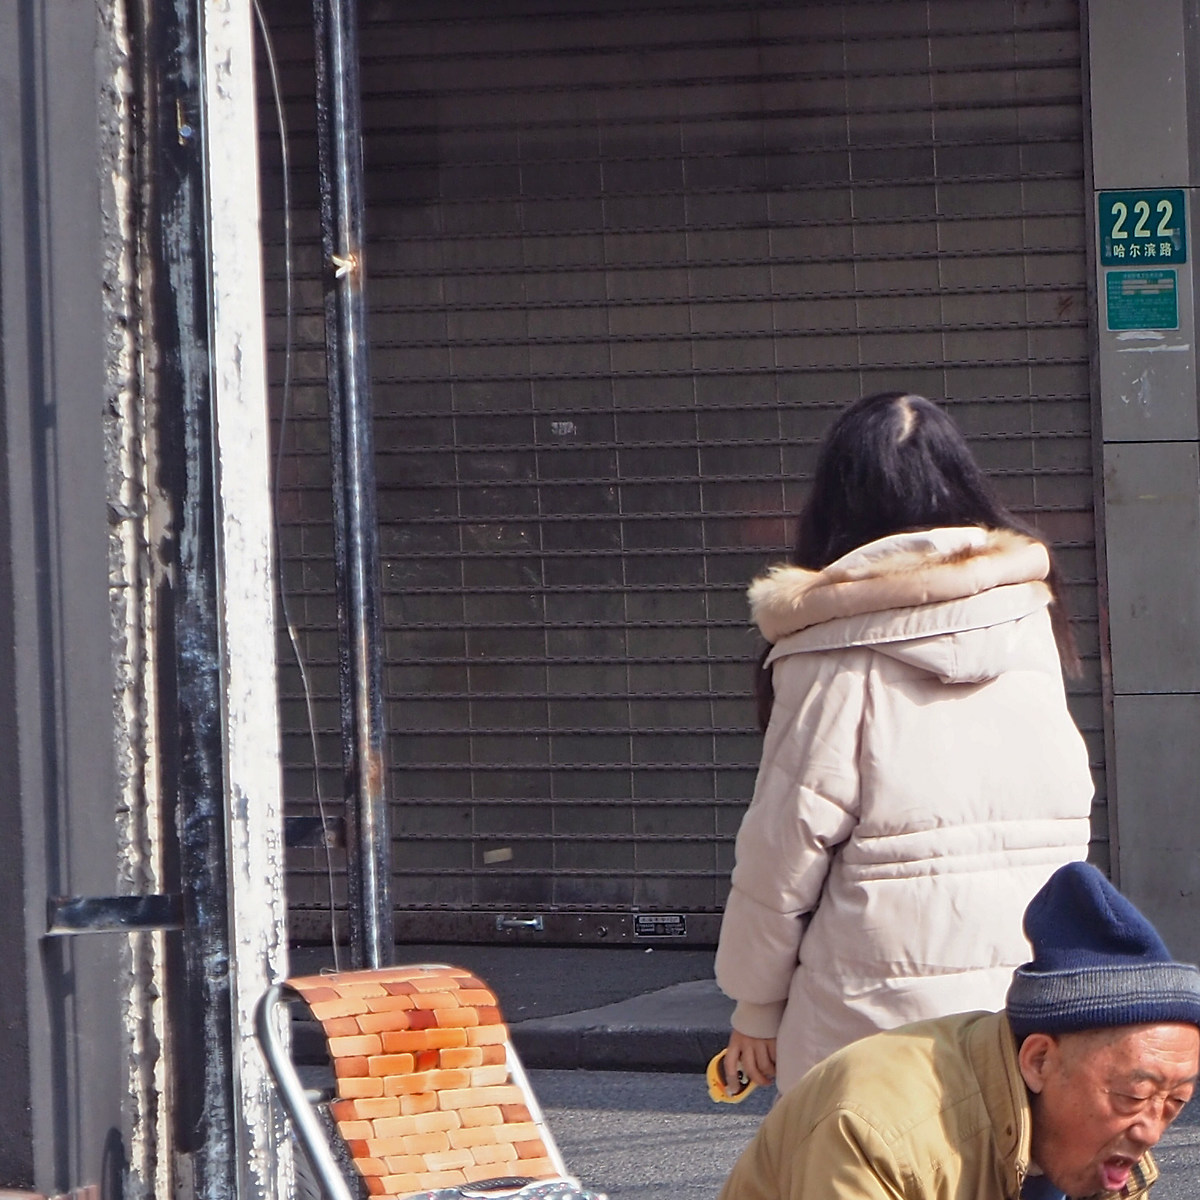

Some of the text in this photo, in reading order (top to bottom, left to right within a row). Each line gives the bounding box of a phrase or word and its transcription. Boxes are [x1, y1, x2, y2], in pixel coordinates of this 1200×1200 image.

[1111, 200, 1173, 239] 222
[1113, 243, 1172, 258] 哈尔滨路
